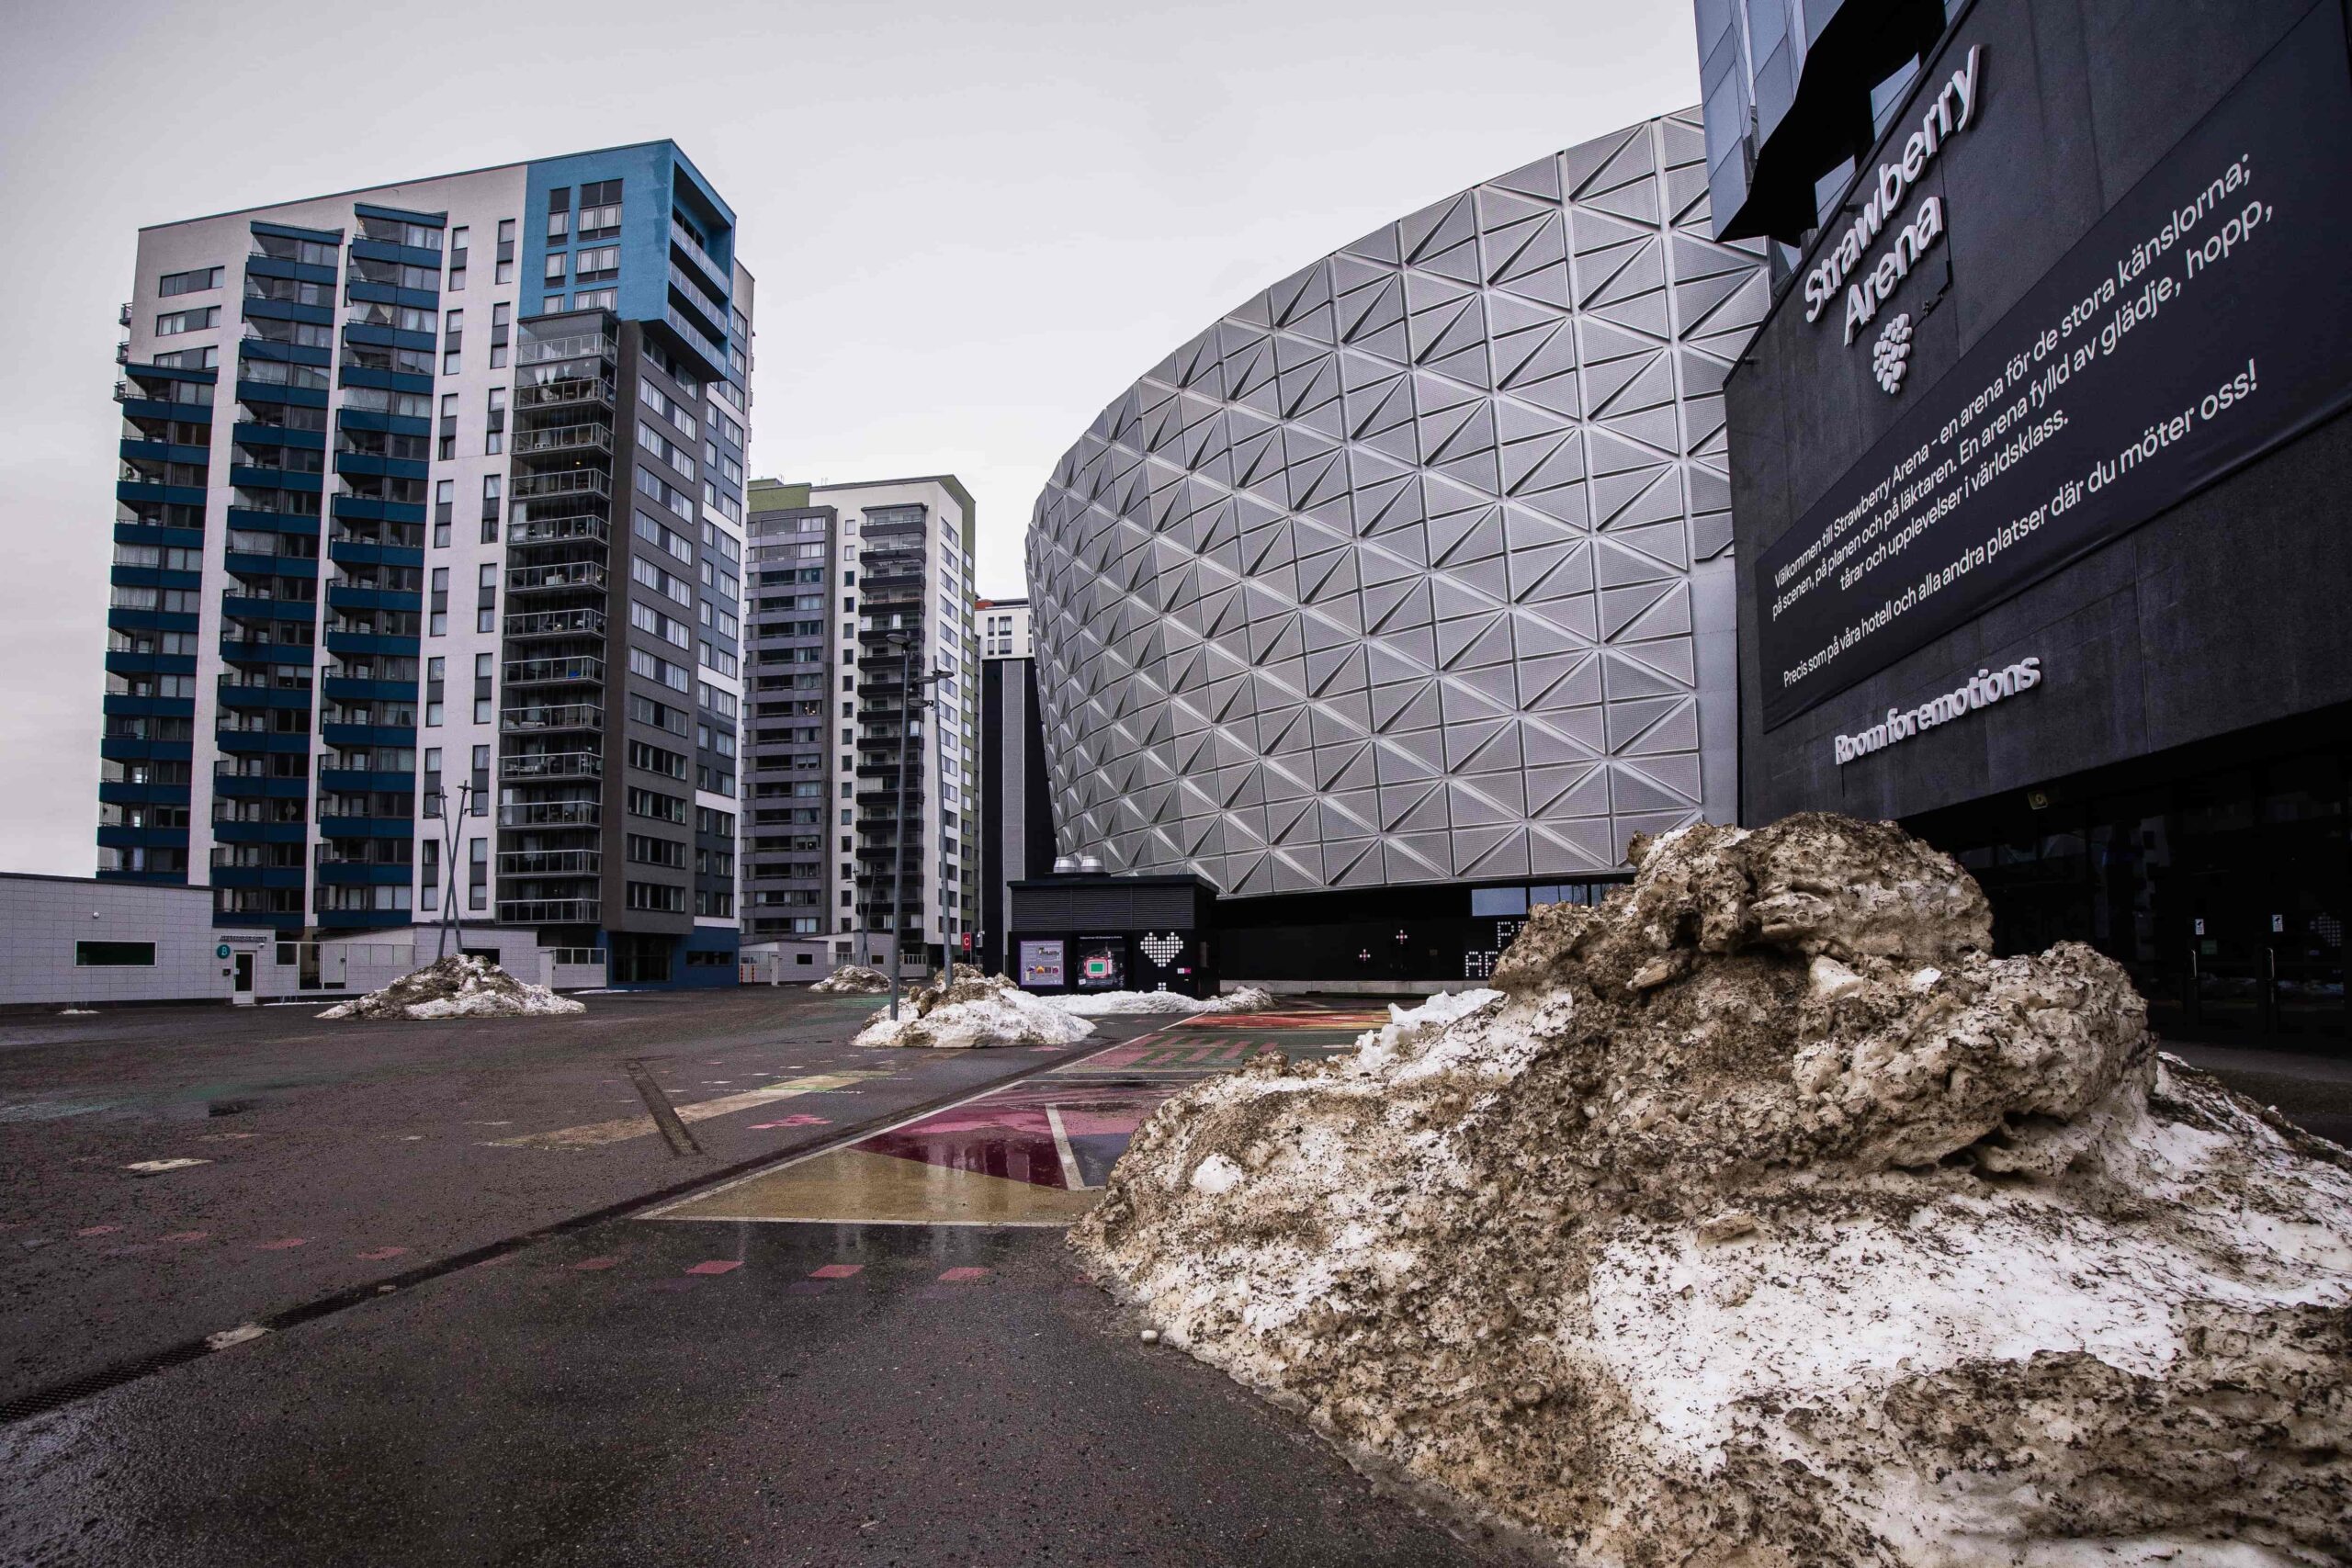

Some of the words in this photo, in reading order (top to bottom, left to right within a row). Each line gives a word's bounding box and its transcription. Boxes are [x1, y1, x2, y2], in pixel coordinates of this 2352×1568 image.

[1804, 44, 1981, 322] Strawberry
[1844, 197, 1943, 347] Arena
[1772, 595, 1782, 622] på
[1782, 575, 1815, 609] scenen,
[1815, 558, 1827, 587] på
[1828, 535, 1860, 577] planen
[1861, 514, 1882, 544] och
[1883, 497, 1899, 532] på
[1901, 458, 1957, 513] läktaren.
[1960, 437, 1979, 466] En
[1982, 397, 2028, 448] arena
[2030, 353, 2070, 410] fylld
[2074, 336, 2097, 372] av
[2101, 276, 2181, 355] glädje,
[2186, 200, 2273, 279] hopp,
[1775, 539, 1822, 589] Välkommen
[1822, 524, 1834, 548] till
[1834, 476, 1891, 538] Strawberry
[1893, 444, 1929, 488] Arena
[1940, 418, 1958, 445] en
[1961, 378, 2004, 428] arena
[2005, 351, 2030, 387] för
[2033, 329, 2058, 362] de
[2062, 277, 2115, 338] stora
[2118, 153, 2250, 289] känslorna;
[1839, 561, 1864, 591] tårar
[1865, 542, 1886, 572] och
[1888, 486, 1962, 556] upplevelser
[1964, 475, 1969, 498] i
[1971, 410, 2068, 491] världsklass.
[1783, 660, 1808, 687] Precis
[1808, 651, 1826, 672] som
[1827, 636, 1839, 664] på
[1839, 627, 1860, 650] våra
[1861, 600, 1892, 638] hotell
[1894, 587, 1917, 616] och
[1918, 572, 1941, 601] alla
[1942, 546, 1984, 586] andra
[1987, 504, 2048, 564] platser
[2052, 480, 2084, 516] där
[2087, 459, 2116, 493] du
[2120, 407, 2195, 474] möter
[2200, 358, 2257, 421] oss!
[964, 937, 969, 946] C
